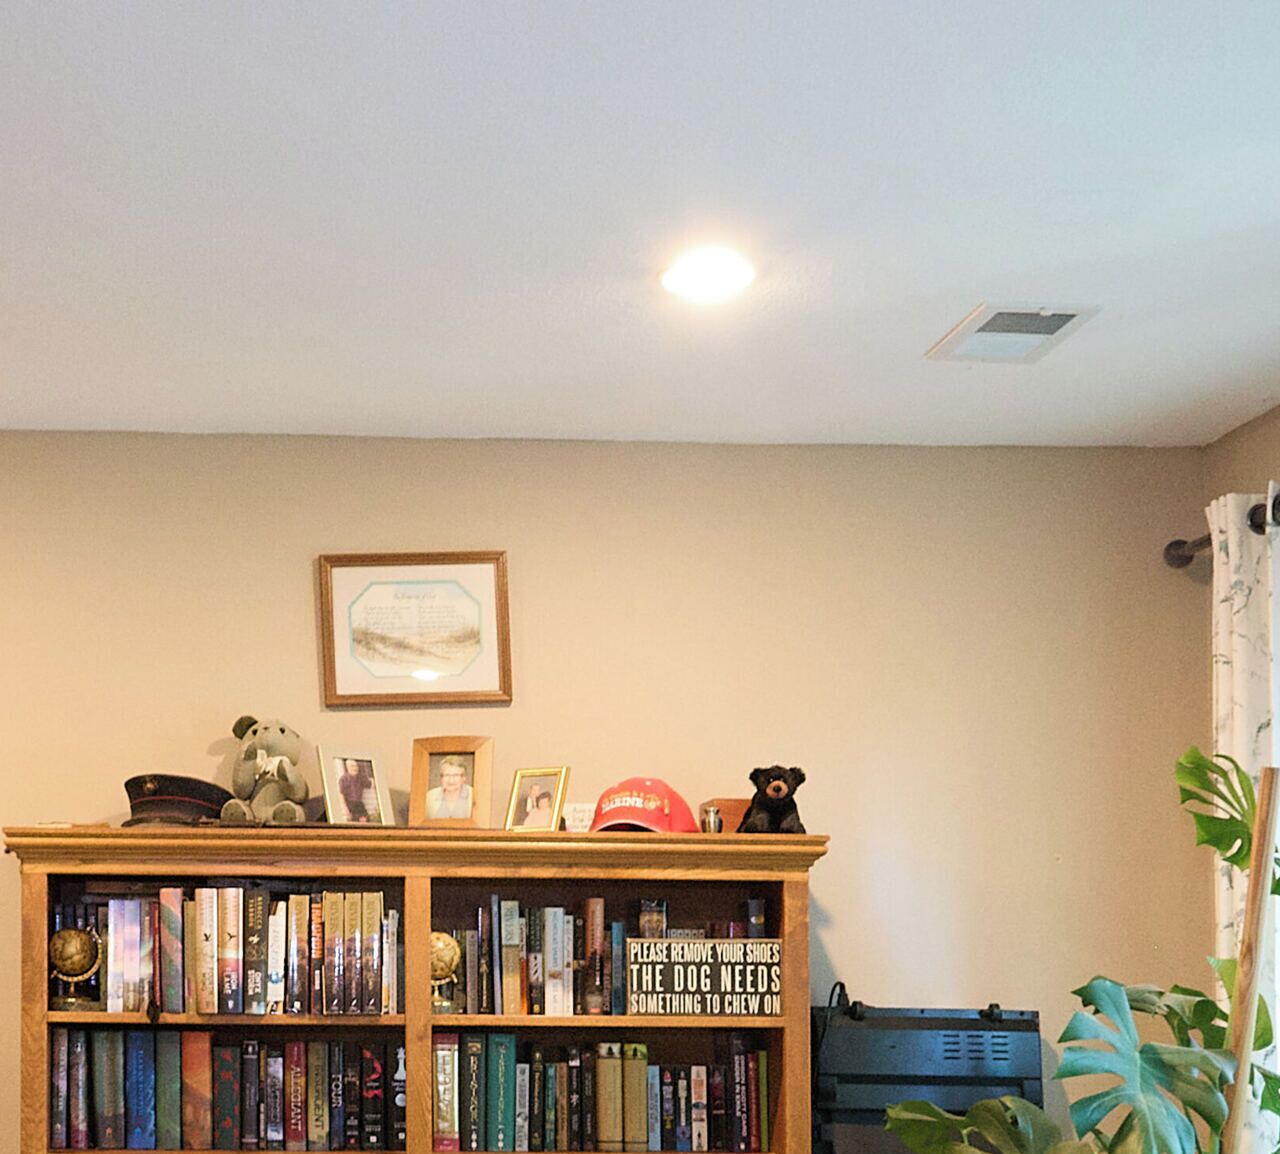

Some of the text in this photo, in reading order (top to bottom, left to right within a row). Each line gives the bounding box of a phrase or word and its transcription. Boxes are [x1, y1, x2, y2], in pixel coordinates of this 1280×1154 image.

[630, 943, 780, 963] PLEASE REMOVE YOUR SHOES
[630, 964, 664, 992] THE
[674, 964, 711, 992] DOG
[720, 964, 780, 993] NEEDS
[631, 993, 781, 1014] SOMETHING TO CHEW ON
[290, 1065, 302, 1131] ALLEGIANT
[332, 1073, 342, 1108] FOUR
